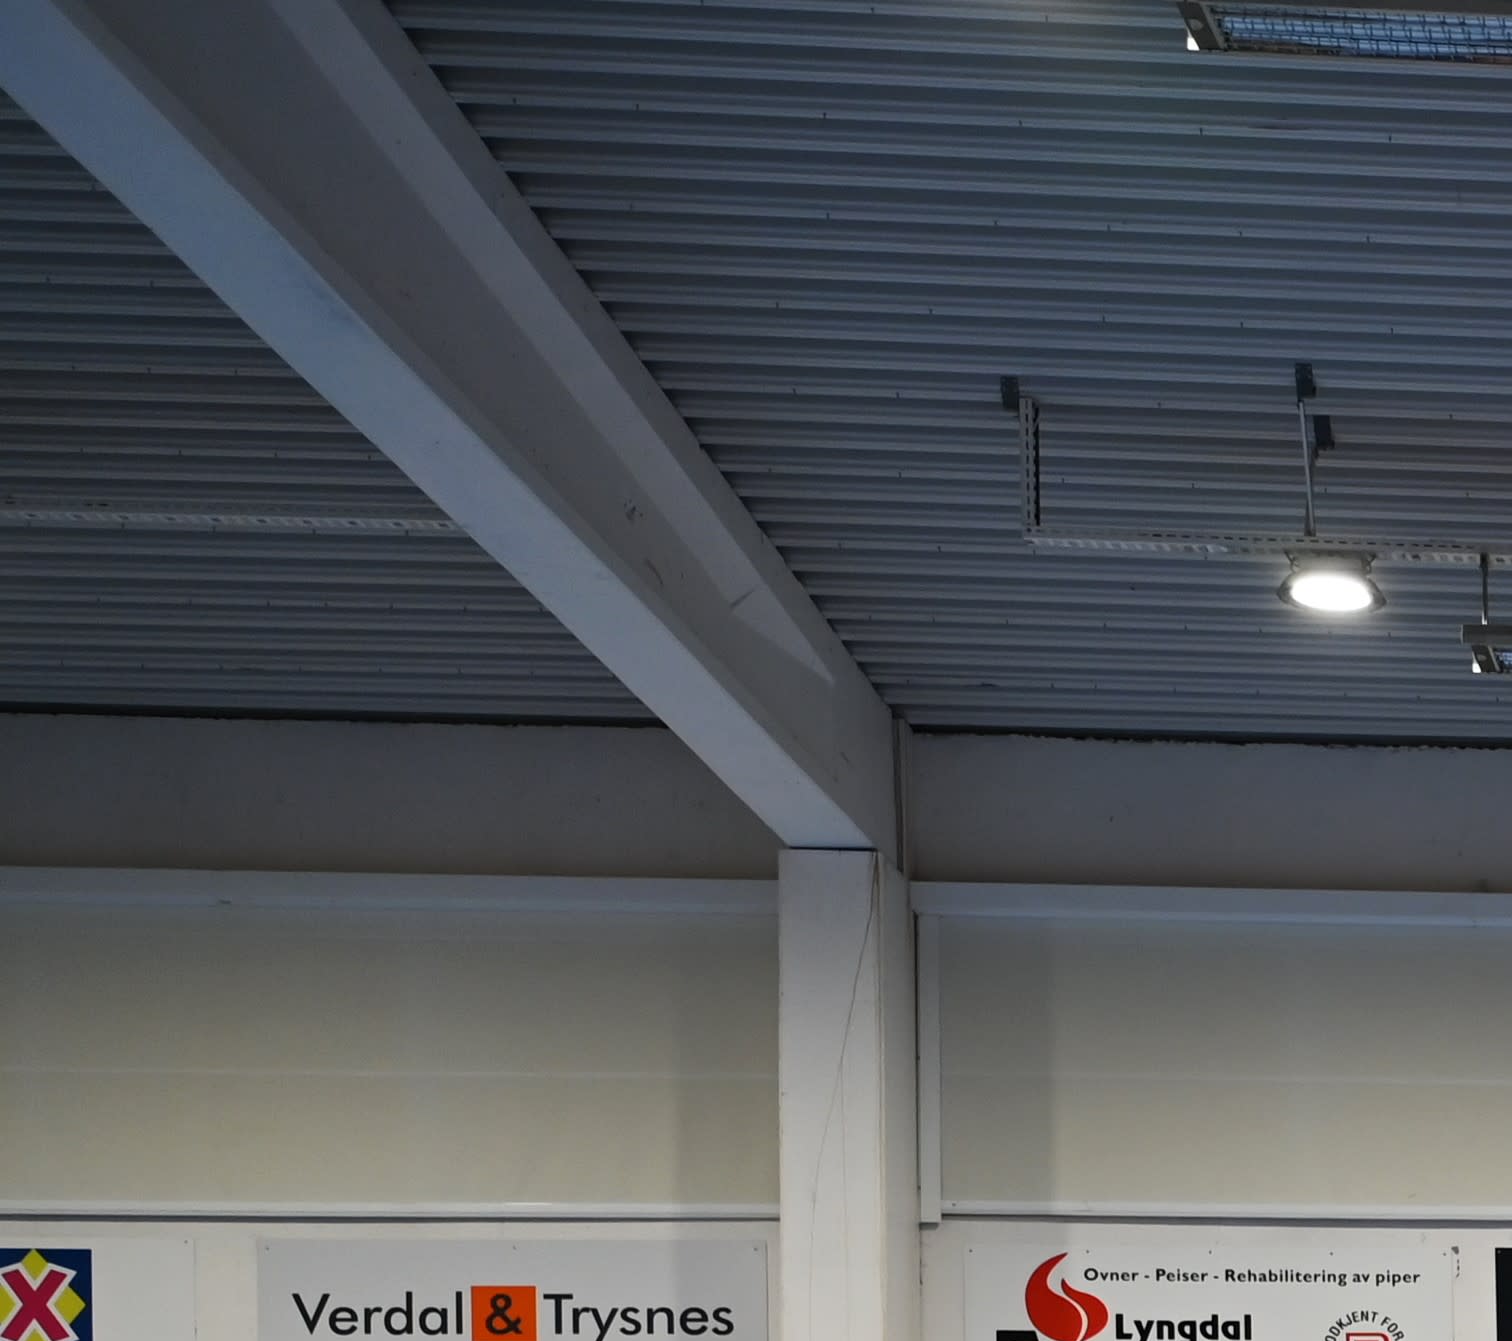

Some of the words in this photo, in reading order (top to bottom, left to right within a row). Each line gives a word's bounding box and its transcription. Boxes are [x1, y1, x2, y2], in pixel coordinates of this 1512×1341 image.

[1083, 1268, 1139, 1284] Ovner
[1155, 1268, 1208, 1284] Peiser
[1224, 1268, 1347, 1288] Rehabilitering
[1351, 1272, 1371, 1286] av
[1375, 1269, 1421, 1288] piper
[292, 1292, 464, 1336] Verdal
[485, 1294, 522, 1335] &
[1380, 1316, 1405, 1341] FOR
